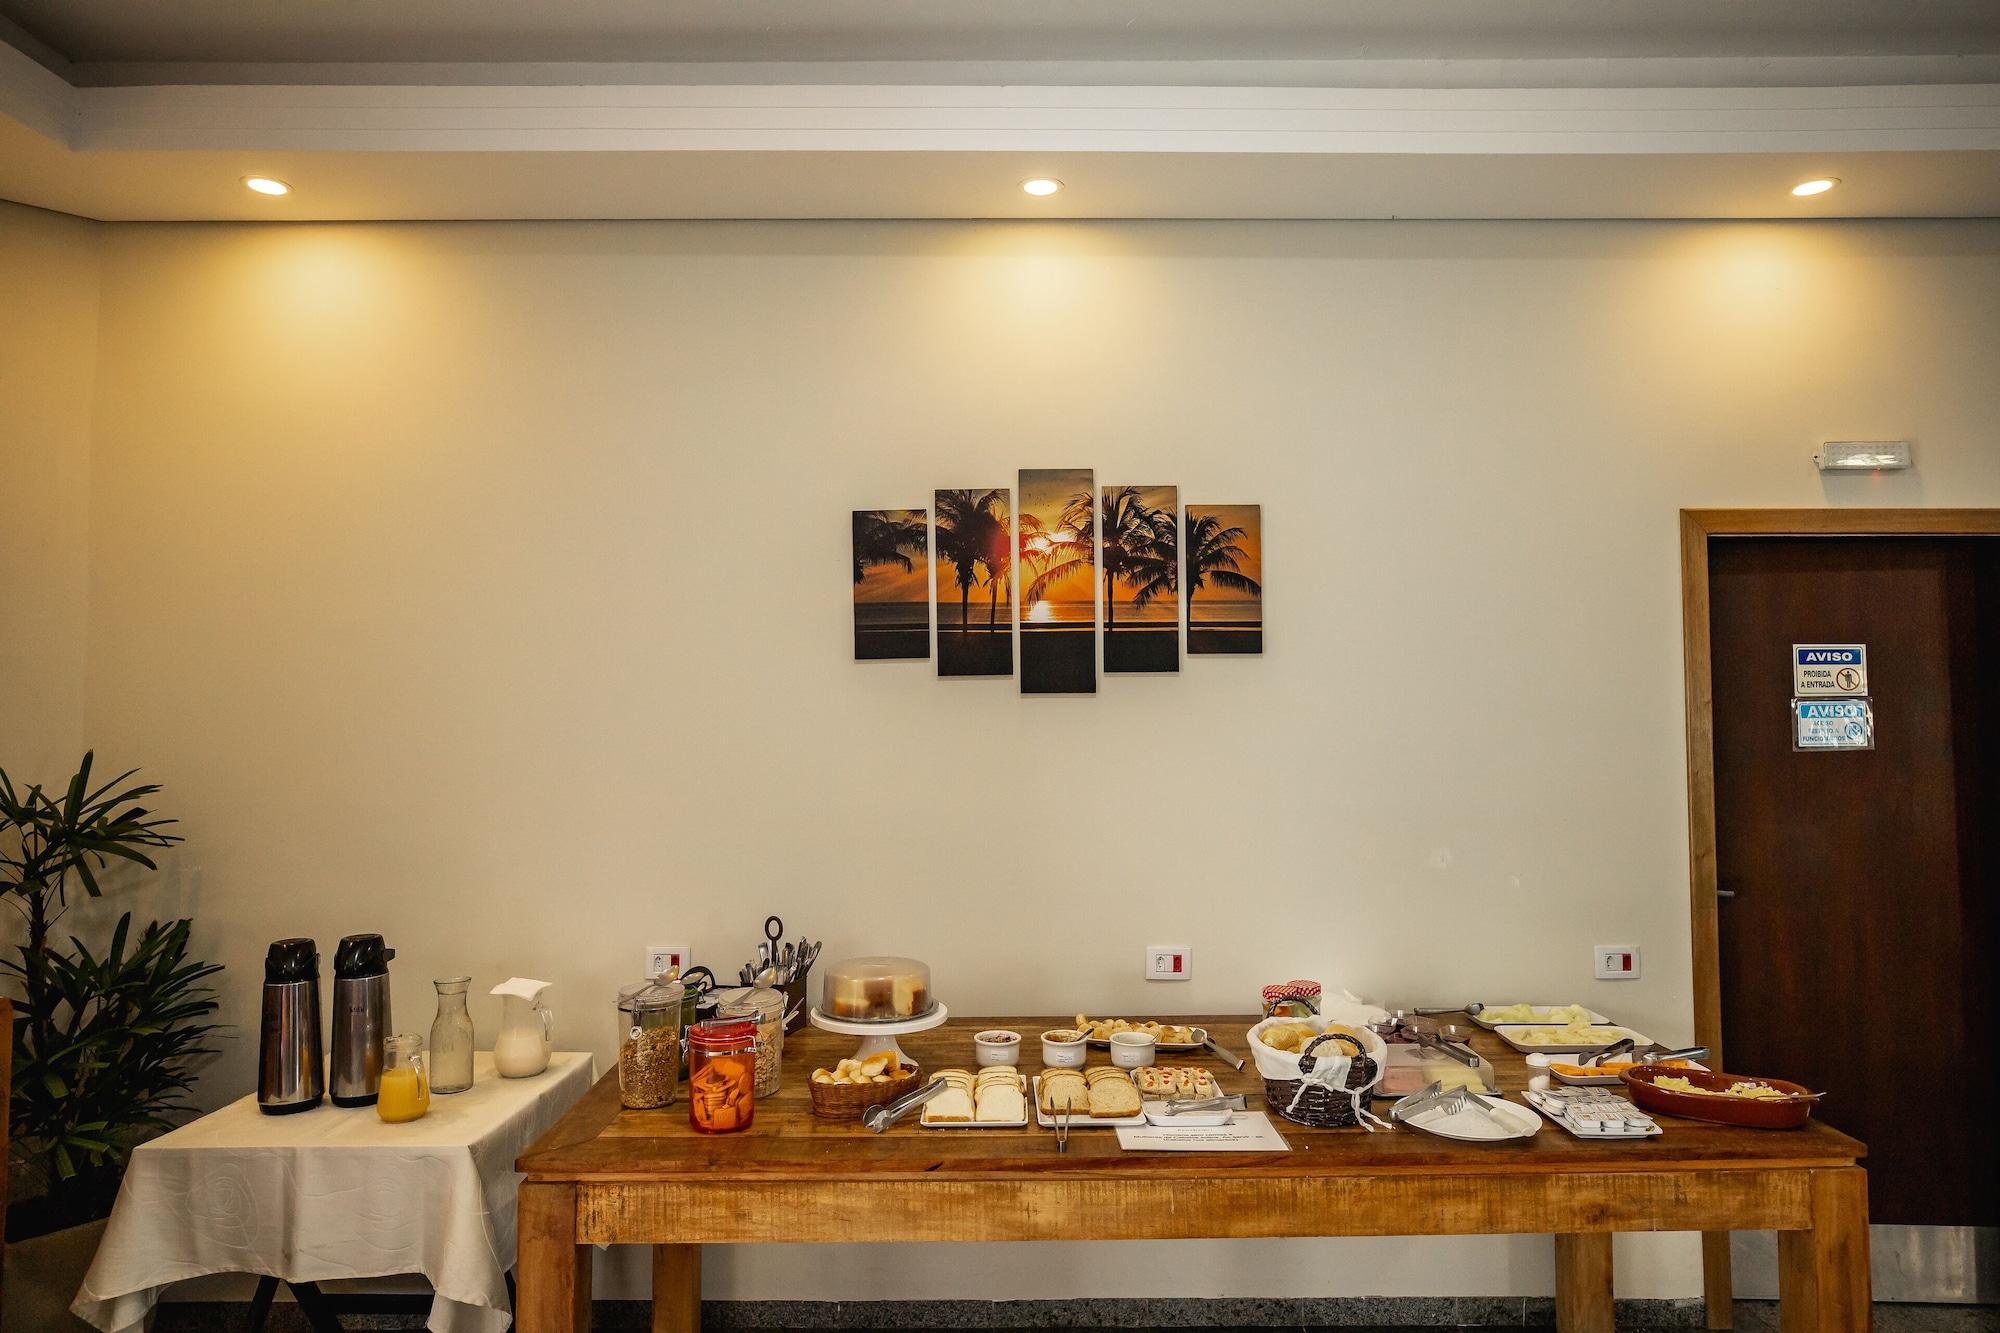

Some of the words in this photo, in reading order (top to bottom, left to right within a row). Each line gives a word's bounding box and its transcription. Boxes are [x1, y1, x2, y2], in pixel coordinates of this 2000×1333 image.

[1806, 653, 1853, 661] AVISO
[1803, 670, 1831, 678] PROIBIDA
[1801, 681, 1806, 689] A
[1807, 680, 1835, 689] ENTRADA
[1808, 706, 1857, 717] AVISO
